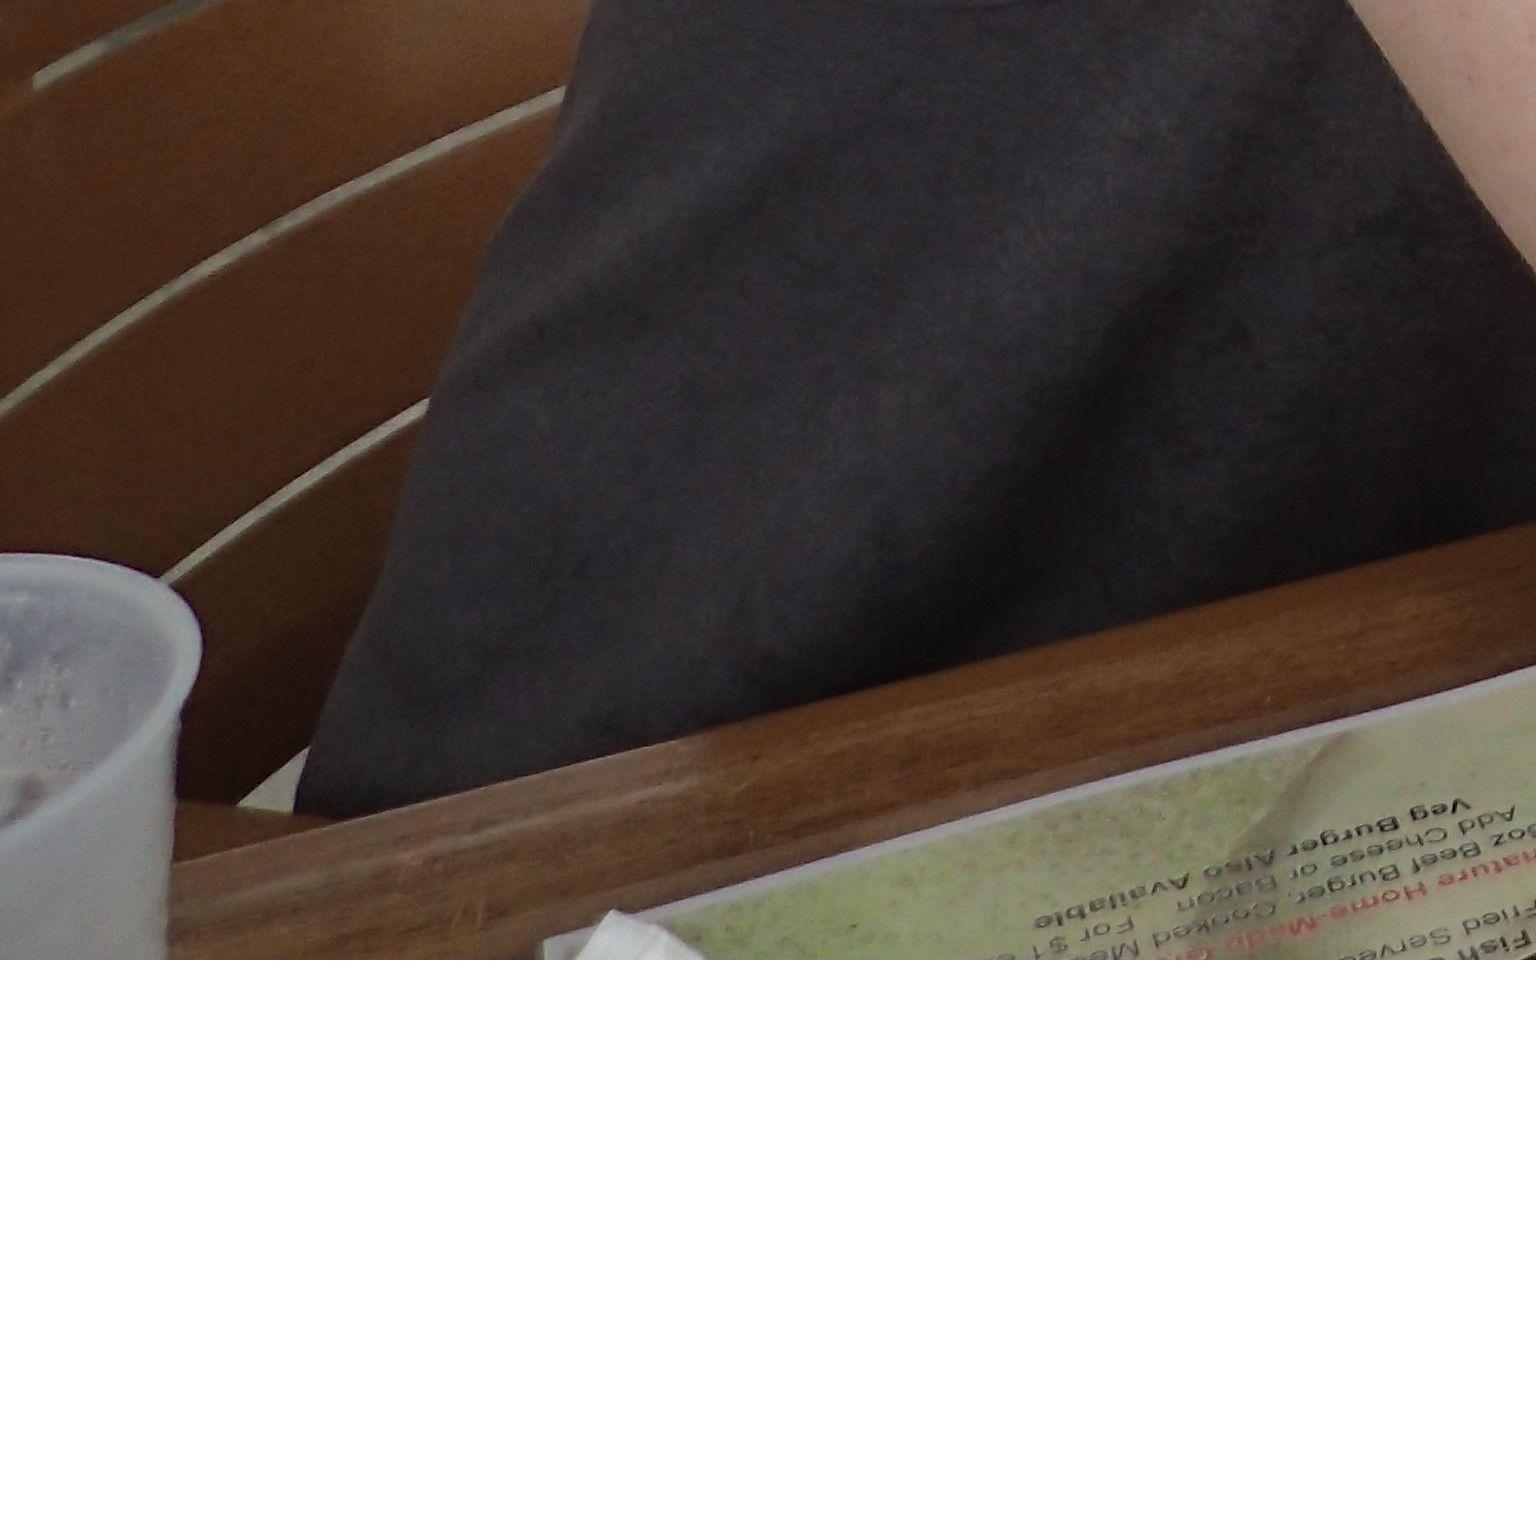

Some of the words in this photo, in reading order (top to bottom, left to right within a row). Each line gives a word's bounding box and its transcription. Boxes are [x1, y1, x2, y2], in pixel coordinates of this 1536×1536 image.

[1408, 797, 1473, 823] Veg
[1459, 804, 1517, 836] Add
[1287, 815, 1401, 858] Burger
[1329, 826, 1449, 869] Cheese
[1202, 847, 1275, 880] Also
[1289, 862, 1319, 880] or
[1410, 840, 1483, 876] Beef
[1032, 871, 1193, 928] Available
[1176, 876, 1277, 912] Bacon
[1079, 915, 1135, 943] For
[1151, 902, 1277, 950] Cooked
[1225, 880, 1429, 951] Home-Made
[1456, 926, 1532, 960] Fish
